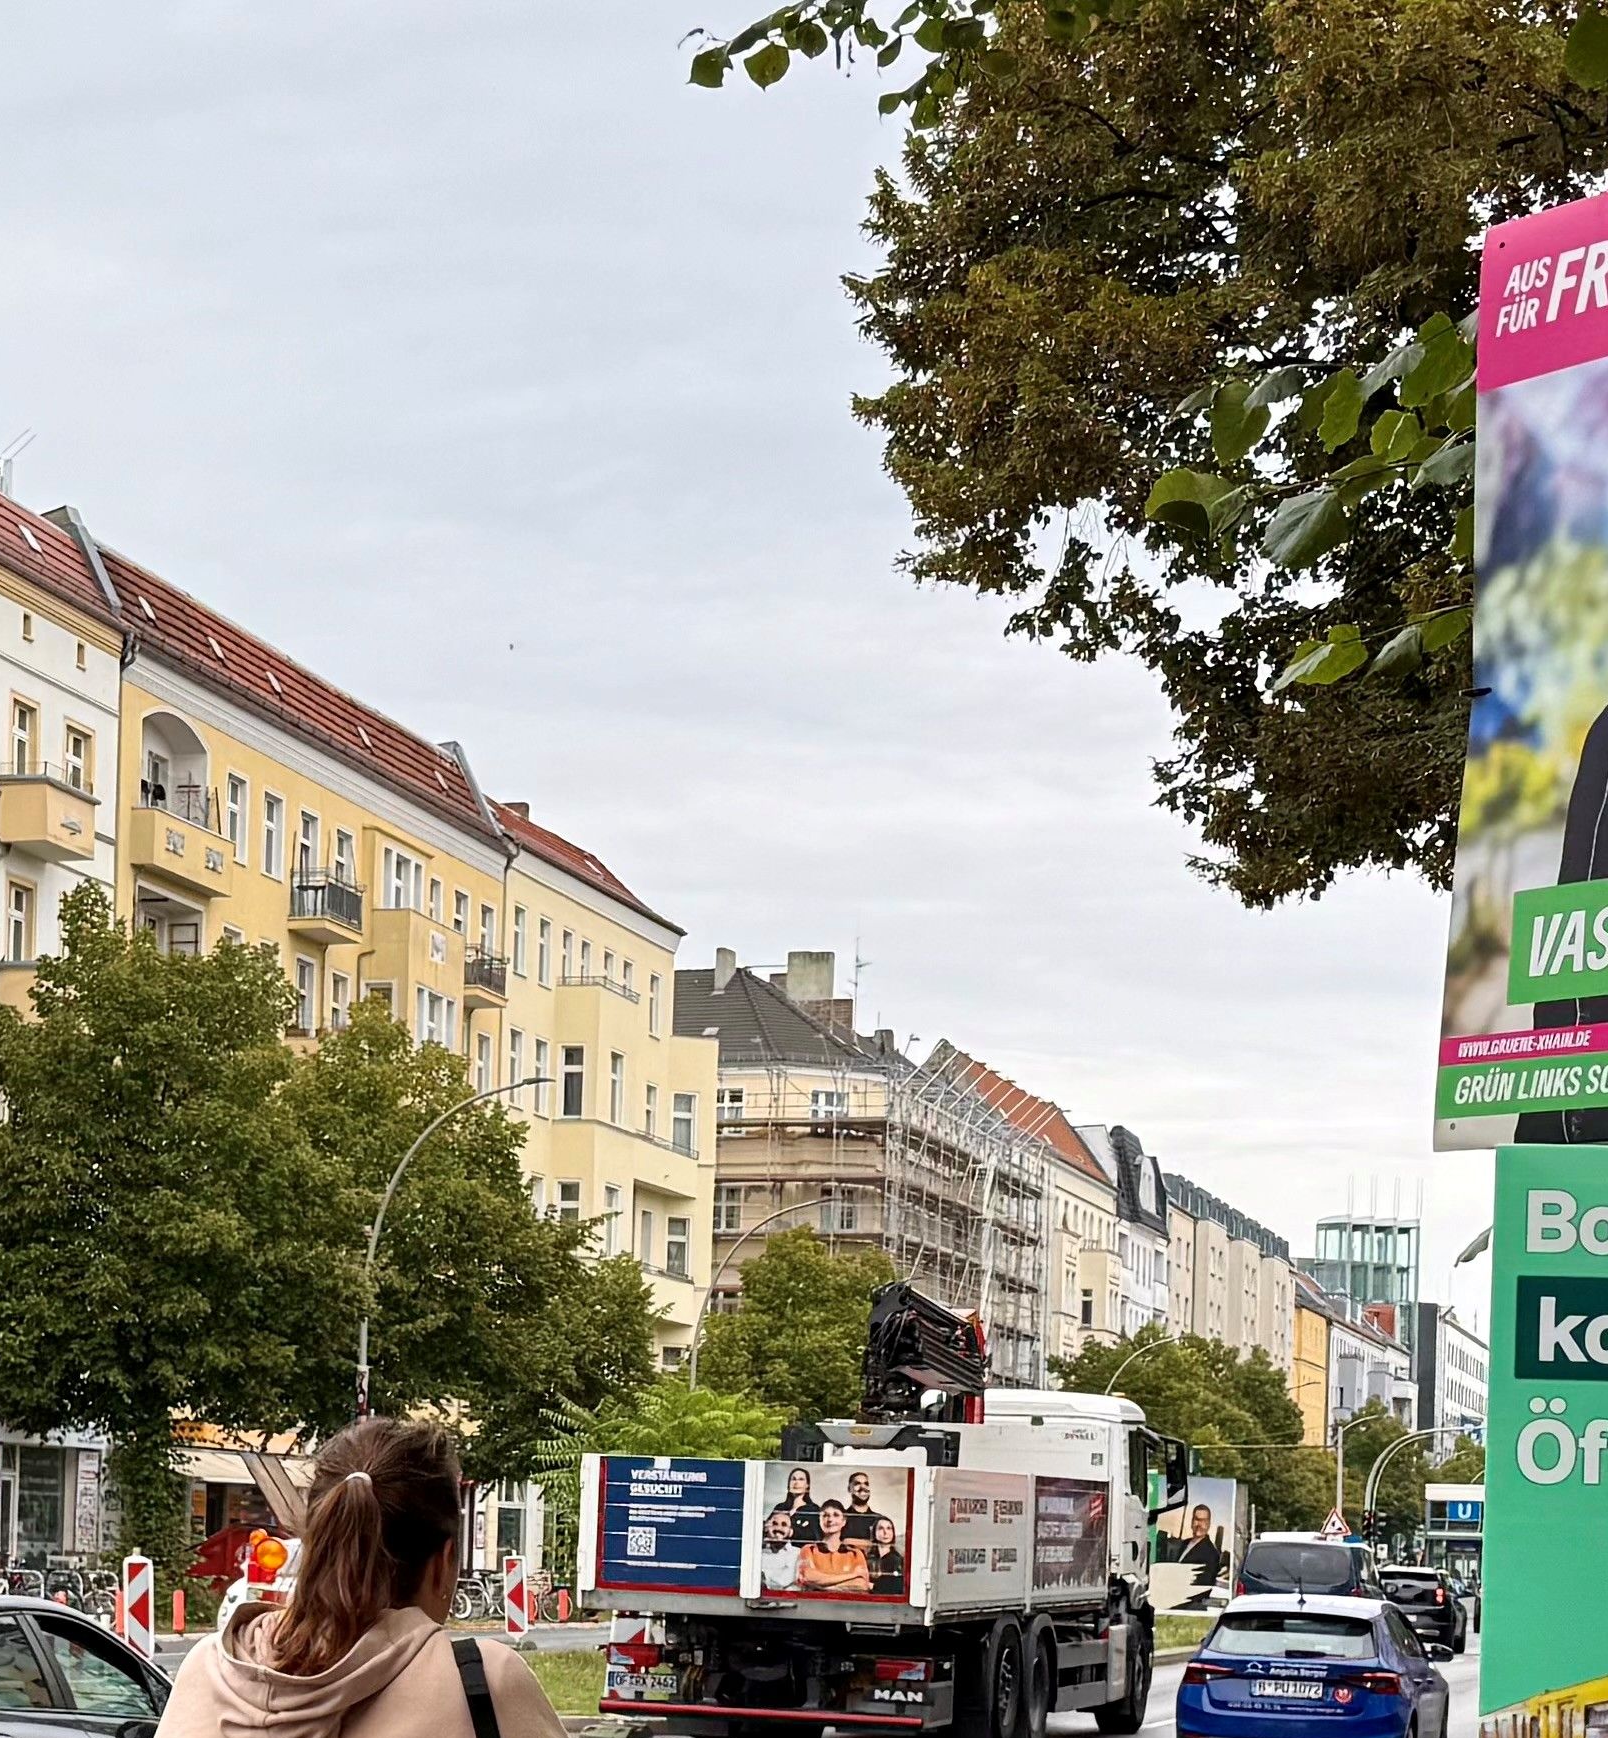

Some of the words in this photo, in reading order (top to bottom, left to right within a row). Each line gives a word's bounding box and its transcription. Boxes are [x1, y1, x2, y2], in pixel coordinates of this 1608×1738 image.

[1504, 255, 1550, 299] AUS
[1495, 293, 1539, 339] FÜR
[1454, 1067, 1516, 1105] GRÜN
[1517, 1067, 1581, 1099] LINKS
[1457, 1502, 1472, 1520] U
[874, 1688, 923, 1703] MAN
